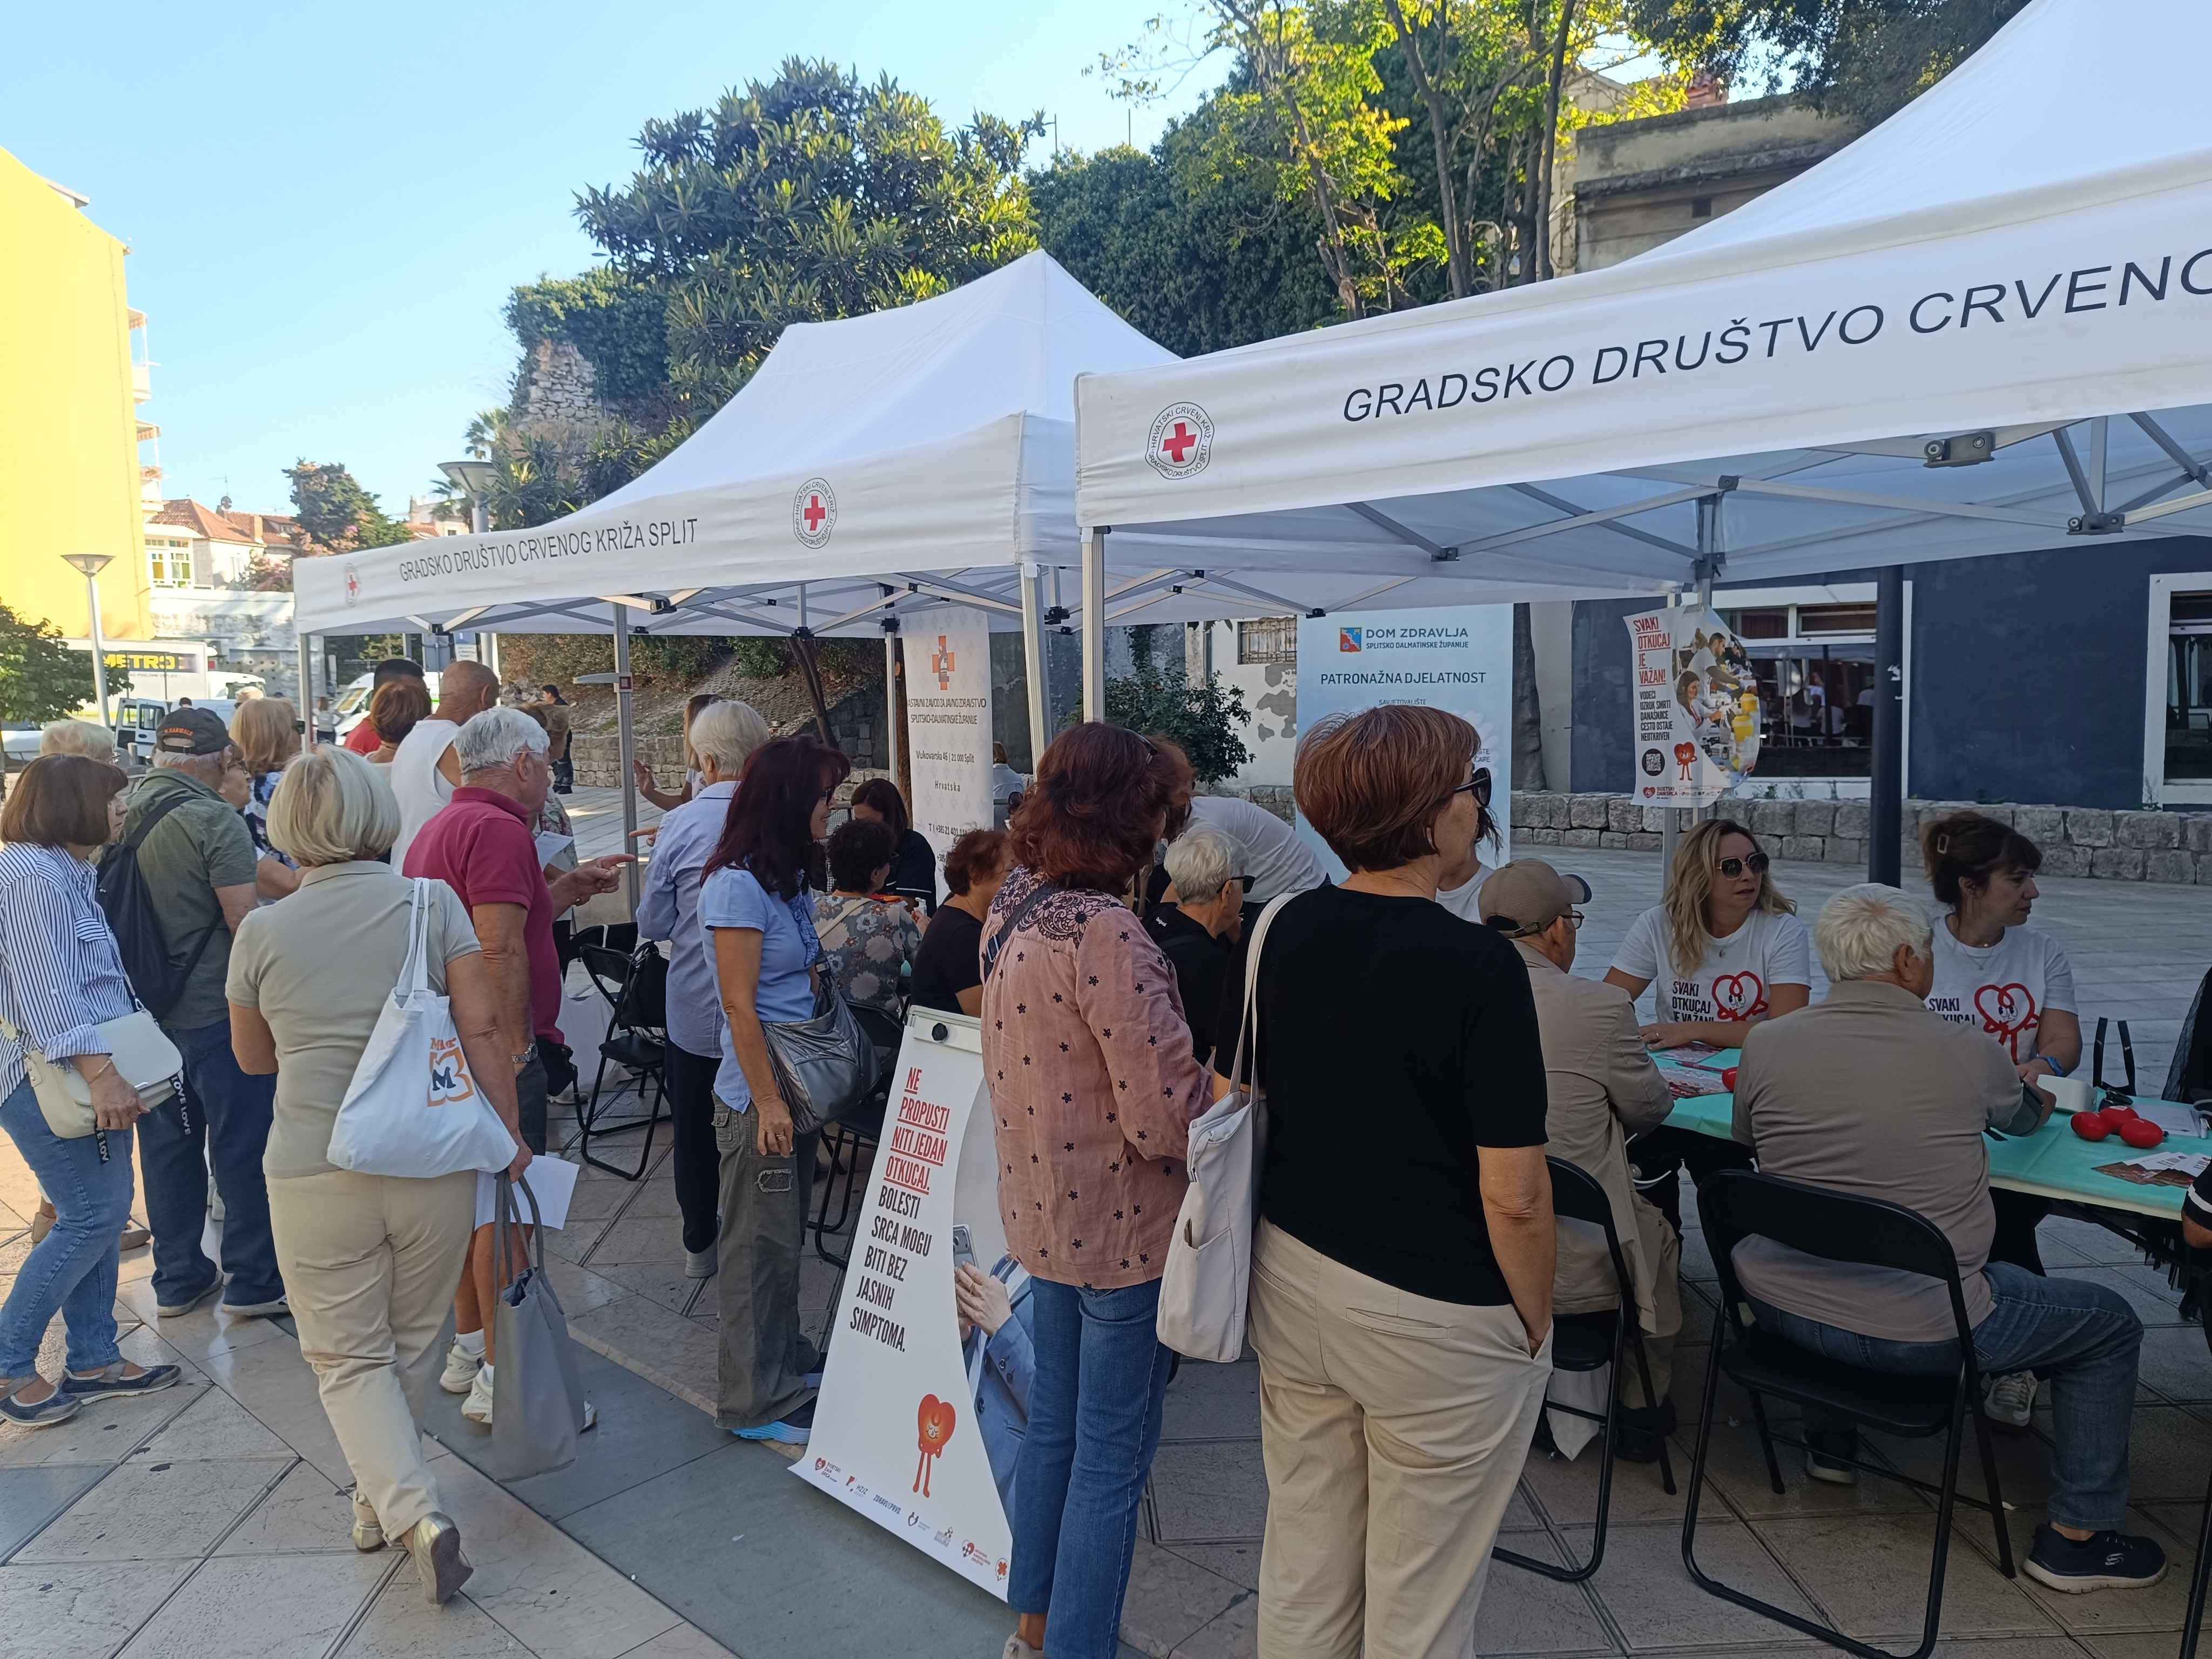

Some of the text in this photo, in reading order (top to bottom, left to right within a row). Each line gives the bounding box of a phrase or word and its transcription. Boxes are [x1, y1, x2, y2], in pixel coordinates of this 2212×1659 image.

[1344, 355, 1574, 421] GRADSKO
[1593, 305, 1884, 385] DRUŠTVO
[1151, 407, 1211, 448] HRVATSKI CRVENI KRIŽ
[1149, 444, 1207, 477] GRADSKO DRUŠTVO SPLIT
[795, 484, 811, 515] HRVATSKI
[812, 482, 830, 495] CRVENI
[399, 518, 698, 582] GRADSKO DRUŠTVO CRVENOG KRIŽA SPLIT
[1633, 616, 1658, 632] SVAKI
[1366, 628, 1468, 638] DOM ZDRAVLJA
[1638, 632, 1670, 649] OTKUCAJ
[103, 654, 176, 670] METRO
[1638, 653, 1645, 667] JE
[1321, 670, 1486, 685] PATRONAŽNA DJELATNOST
[1639, 667, 1665, 684] VAŽAN!
[1640, 689, 1656, 699] VODEĆI
[1640, 700, 1670, 710] UZROK SMRTI
[1641, 710, 1668, 720] DANAŠNJICE
[1641, 720, 1673, 731] ČESTO OSTAJE
[1641, 732, 1669, 741] NEOTKRIVEN
[916, 751, 942, 760] Vukovarska
[965, 753, 974, 765] Split
[935, 780, 960, 792] Hrvatska
[945, 826, 949, 835] 21
[1673, 981, 1699, 996] SVAKI
[1673, 996, 1710, 1014] OTKUCAJ
[1929, 997, 1959, 1011] SVAKI
[906, 1067, 922, 1090] NE
[171, 1076, 191, 1135] LOVE LOVE
[899, 1096, 950, 1130] PROPUSTI
[892, 1126, 948, 1162] NITI JEDAN
[886, 1156, 930, 1191] OTKUCAJ.
[878, 1185, 921, 1219] BOLESTI
[872, 1215, 932, 1257] SRCA MOGU
[864, 1245, 908, 1282] BITI BEZ
[856, 1276, 895, 1311] JASNIH
[850, 1307, 905, 1352] SIMPTOMA.
[827, 1462, 841, 1473] SVJETSKI
